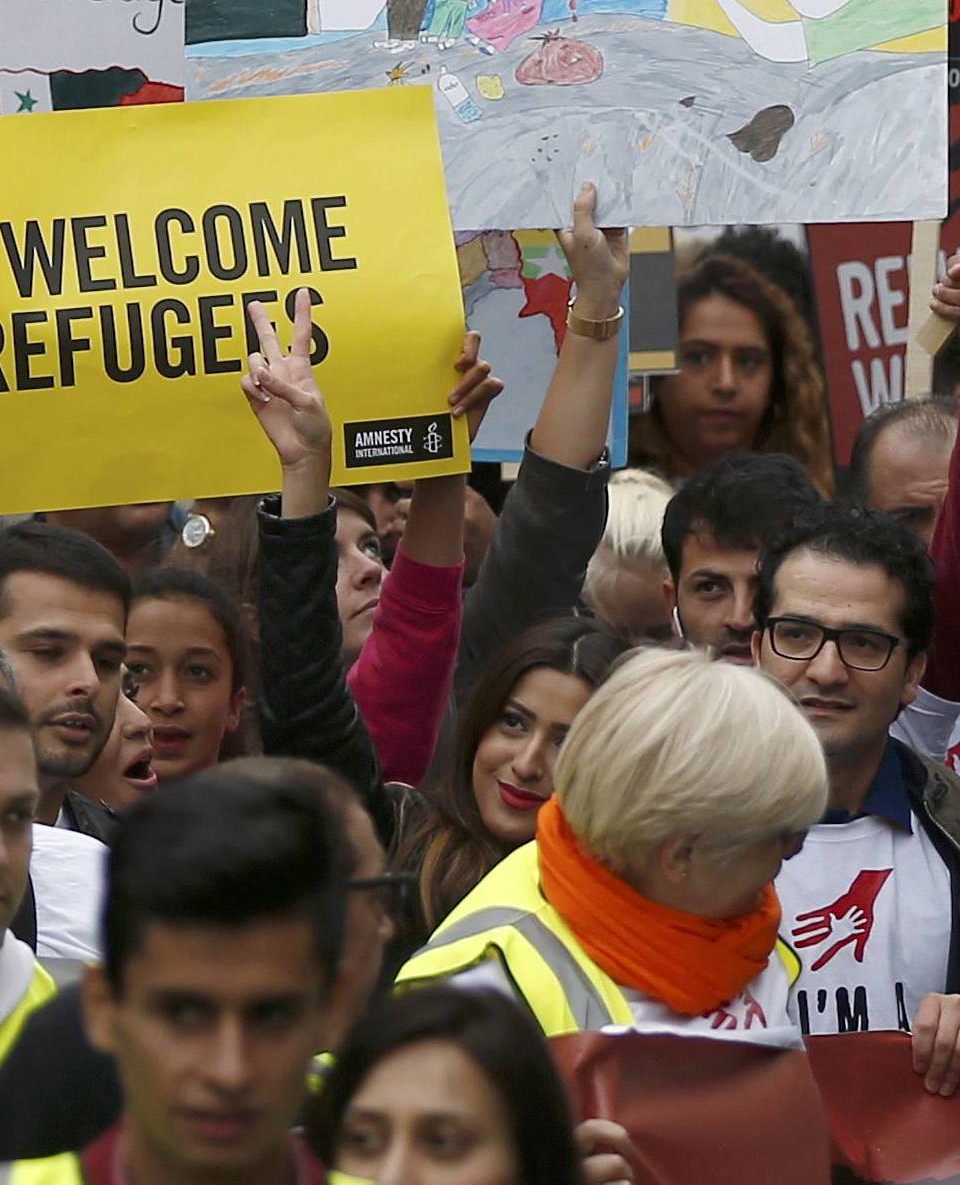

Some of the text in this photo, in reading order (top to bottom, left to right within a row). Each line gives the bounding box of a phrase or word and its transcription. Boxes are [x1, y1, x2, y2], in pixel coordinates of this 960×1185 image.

[0, 196, 357, 298] WELCOME
[355, 428, 413, 447] AMNESTY
[355, 445, 413, 458] INTERNATIONAL
[798, 986, 868, 1035] I'M
